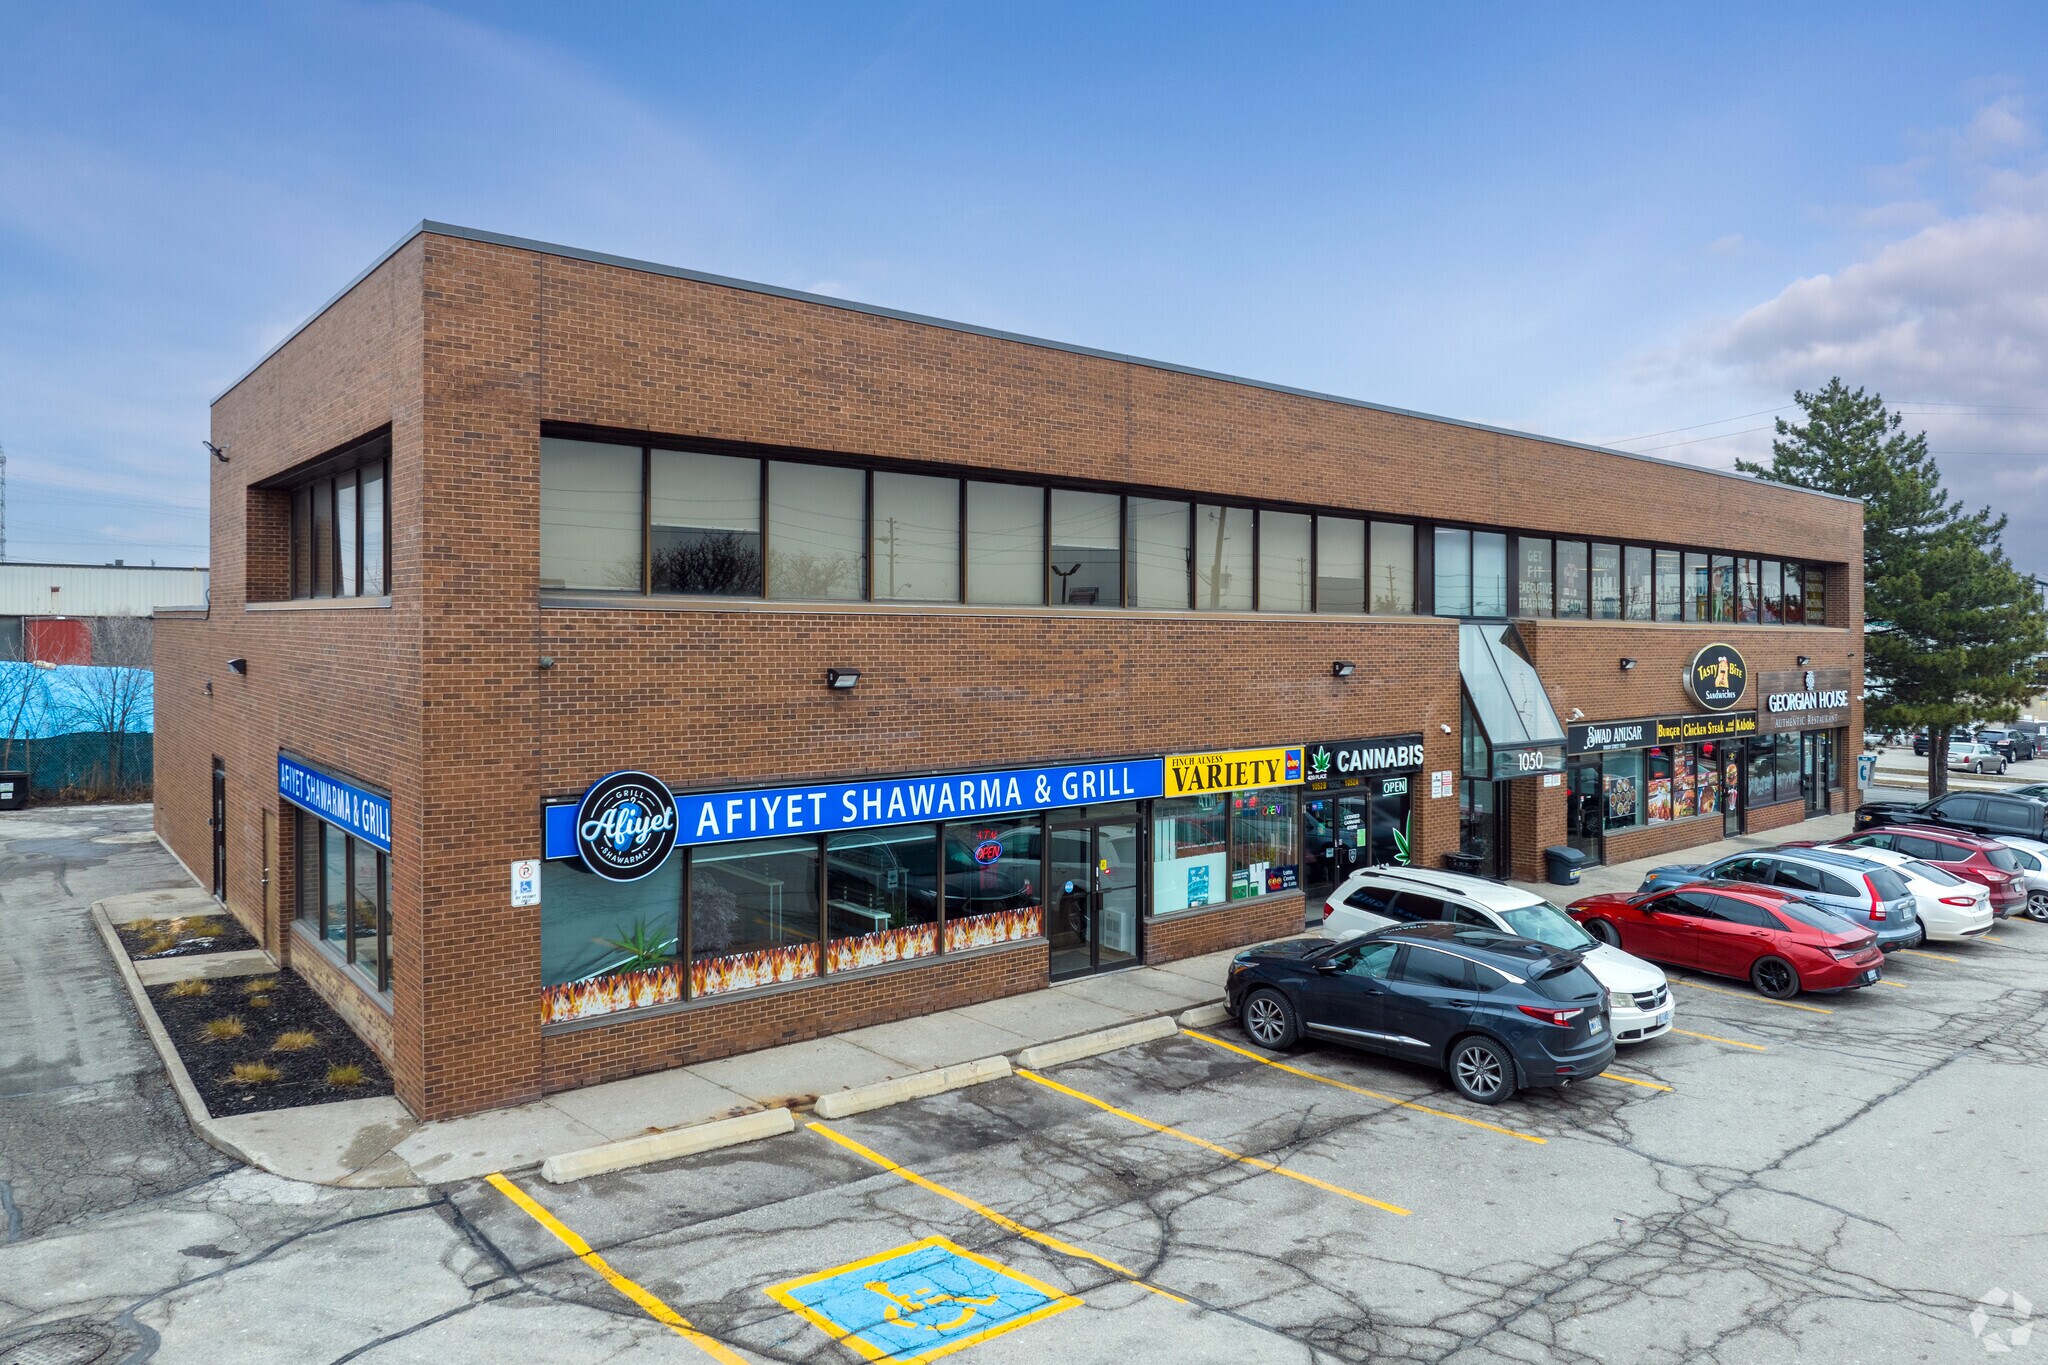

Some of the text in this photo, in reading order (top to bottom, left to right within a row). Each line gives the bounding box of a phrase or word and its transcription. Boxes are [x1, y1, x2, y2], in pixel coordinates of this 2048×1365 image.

[1527, 550, 1543, 562] GET
[1595, 556, 1617, 569] GROUP
[1527, 565, 1543, 578] FIT
[1518, 581, 1553, 595] EXECUTIVE
[1518, 597, 1553, 610] TRAINING
[1560, 598, 1584, 612] READY
[1769, 690, 1849, 712] GEORGIAN HOUSE
[1583, 725, 1643, 749] SWAD ANUSAR
[1172, 755, 1223, 767] FINCH ALNESS
[1337, 744, 1424, 772] CANNABIS
[1518, 751, 1543, 771] 1050
[1172, 758, 1280, 792] VARIETY
[616, 789, 644, 799] GRILL
[1383, 781, 1405, 793] OPEN
[280, 763, 391, 843] AFIYET SHAWARMA & GRILL
[696, 766, 1135, 837] AFIYET SHAWARMA & GRILL
[1262, 805, 1281, 817] OPEN
[581, 806, 674, 845] Afiyet
[976, 829, 998, 840] ATM
[602, 847, 649, 864] SHAWARMA
[976, 845, 1000, 860] OPEN
